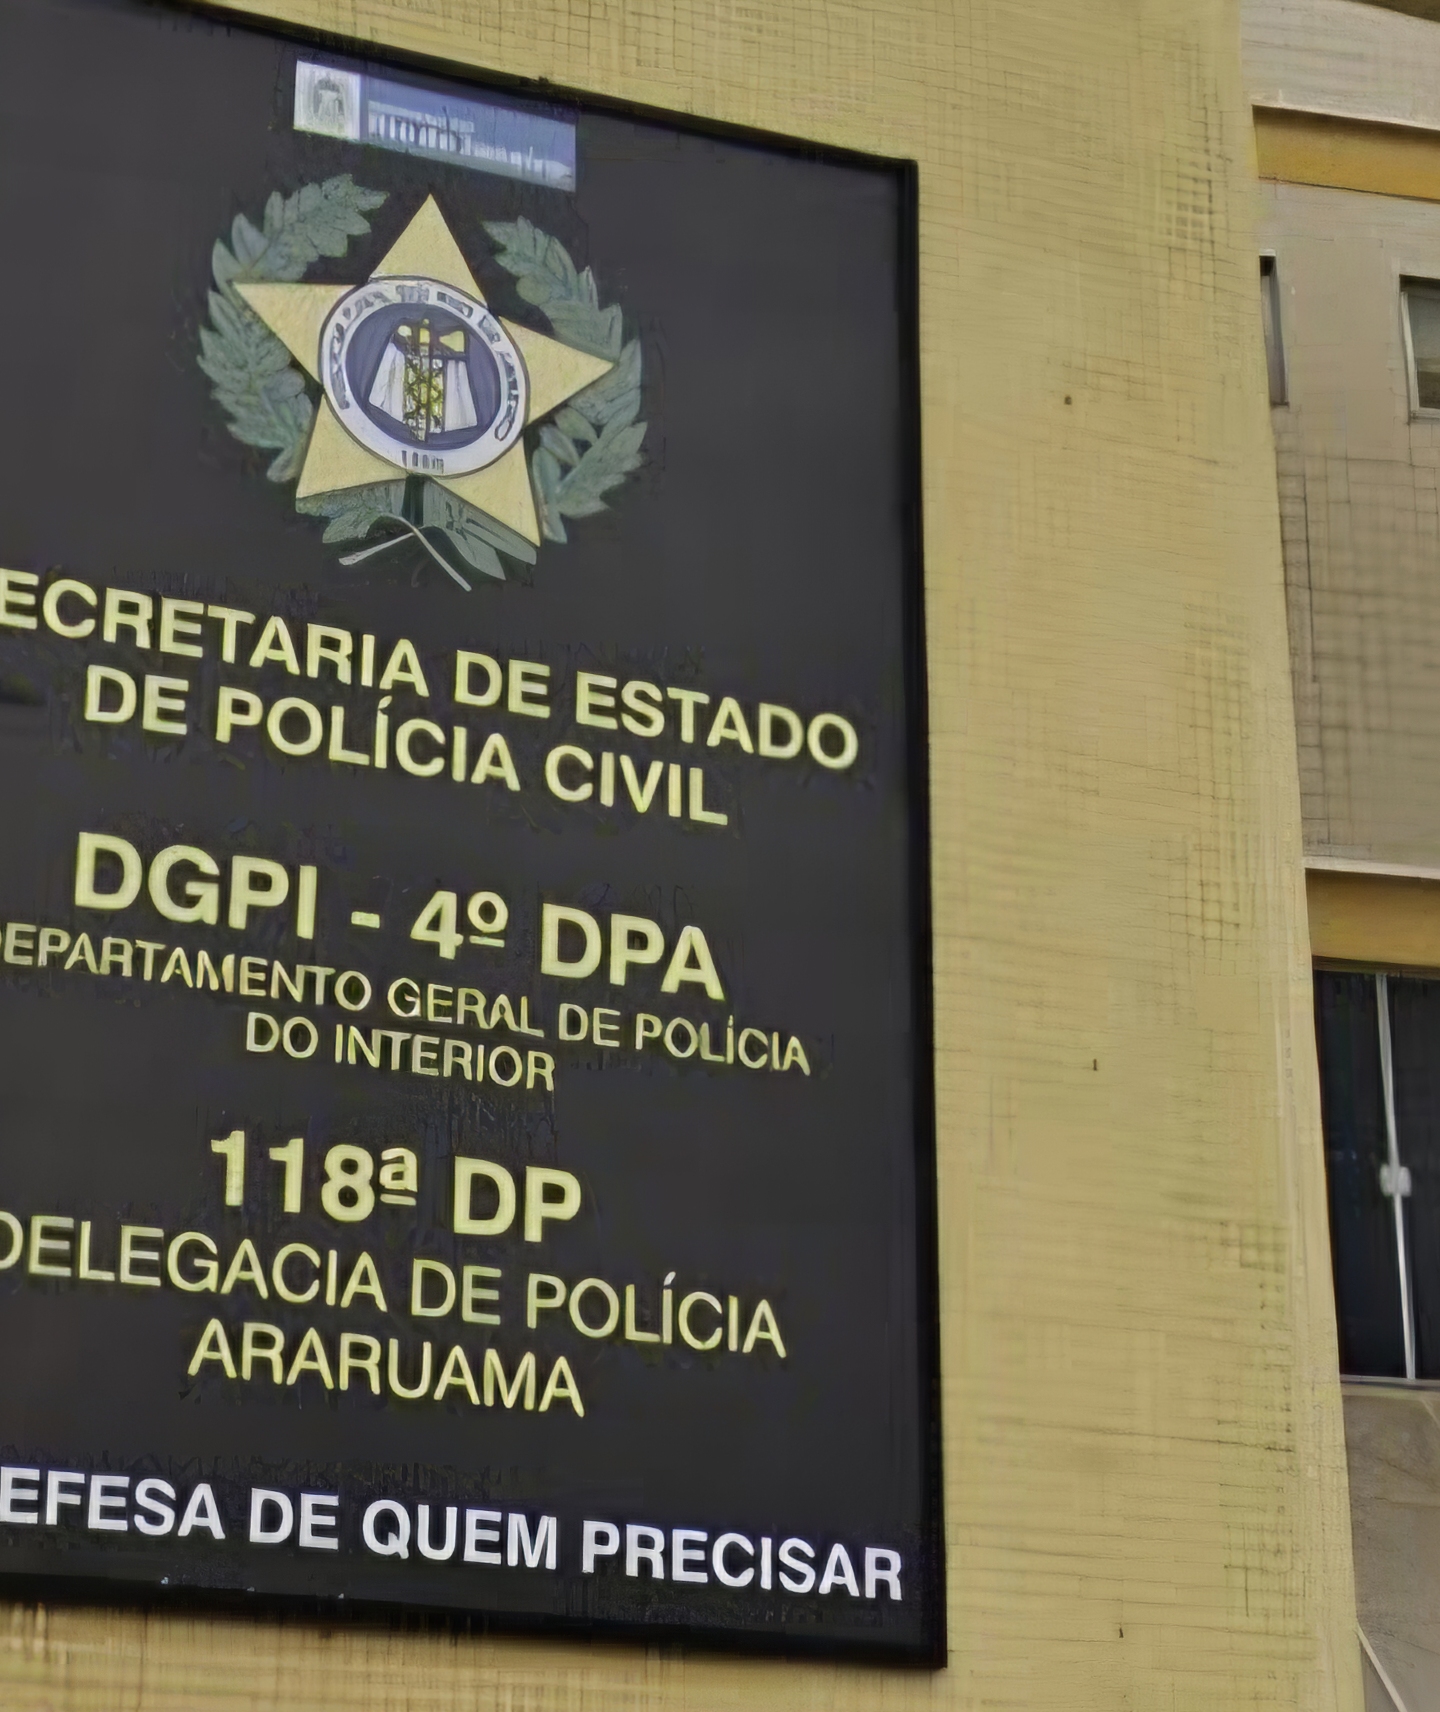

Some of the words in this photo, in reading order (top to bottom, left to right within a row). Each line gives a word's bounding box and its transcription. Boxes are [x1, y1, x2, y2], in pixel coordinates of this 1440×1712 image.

[84, 663, 190, 736] DE
[215, 685, 521, 792] POLÍCIA
[544, 744, 728, 826] CIVIL
[454, 649, 551, 719] DE
[575, 670, 859, 770] ESTADO
[74, 830, 318, 940] DGPI
[350, 910, 381, 929] -
[540, 903, 725, 1001] DPA
[245, 1011, 319, 1059] DO
[334, 1023, 555, 1092] INTERIOR
[387, 976, 545, 1039] GERAL
[558, 1002, 621, 1048] DE
[635, 1014, 811, 1076] POLÍCIA
[453, 1156, 582, 1243] DP
[411, 1258, 502, 1325] DE
[526, 1271, 787, 1359] POLÍCIA
[187, 1317, 585, 1418] ARARUAMA
[249, 1487, 339, 1550] DE
[362, 1499, 558, 1570] QUEM
[582, 1520, 902, 1601] PRECISAR
